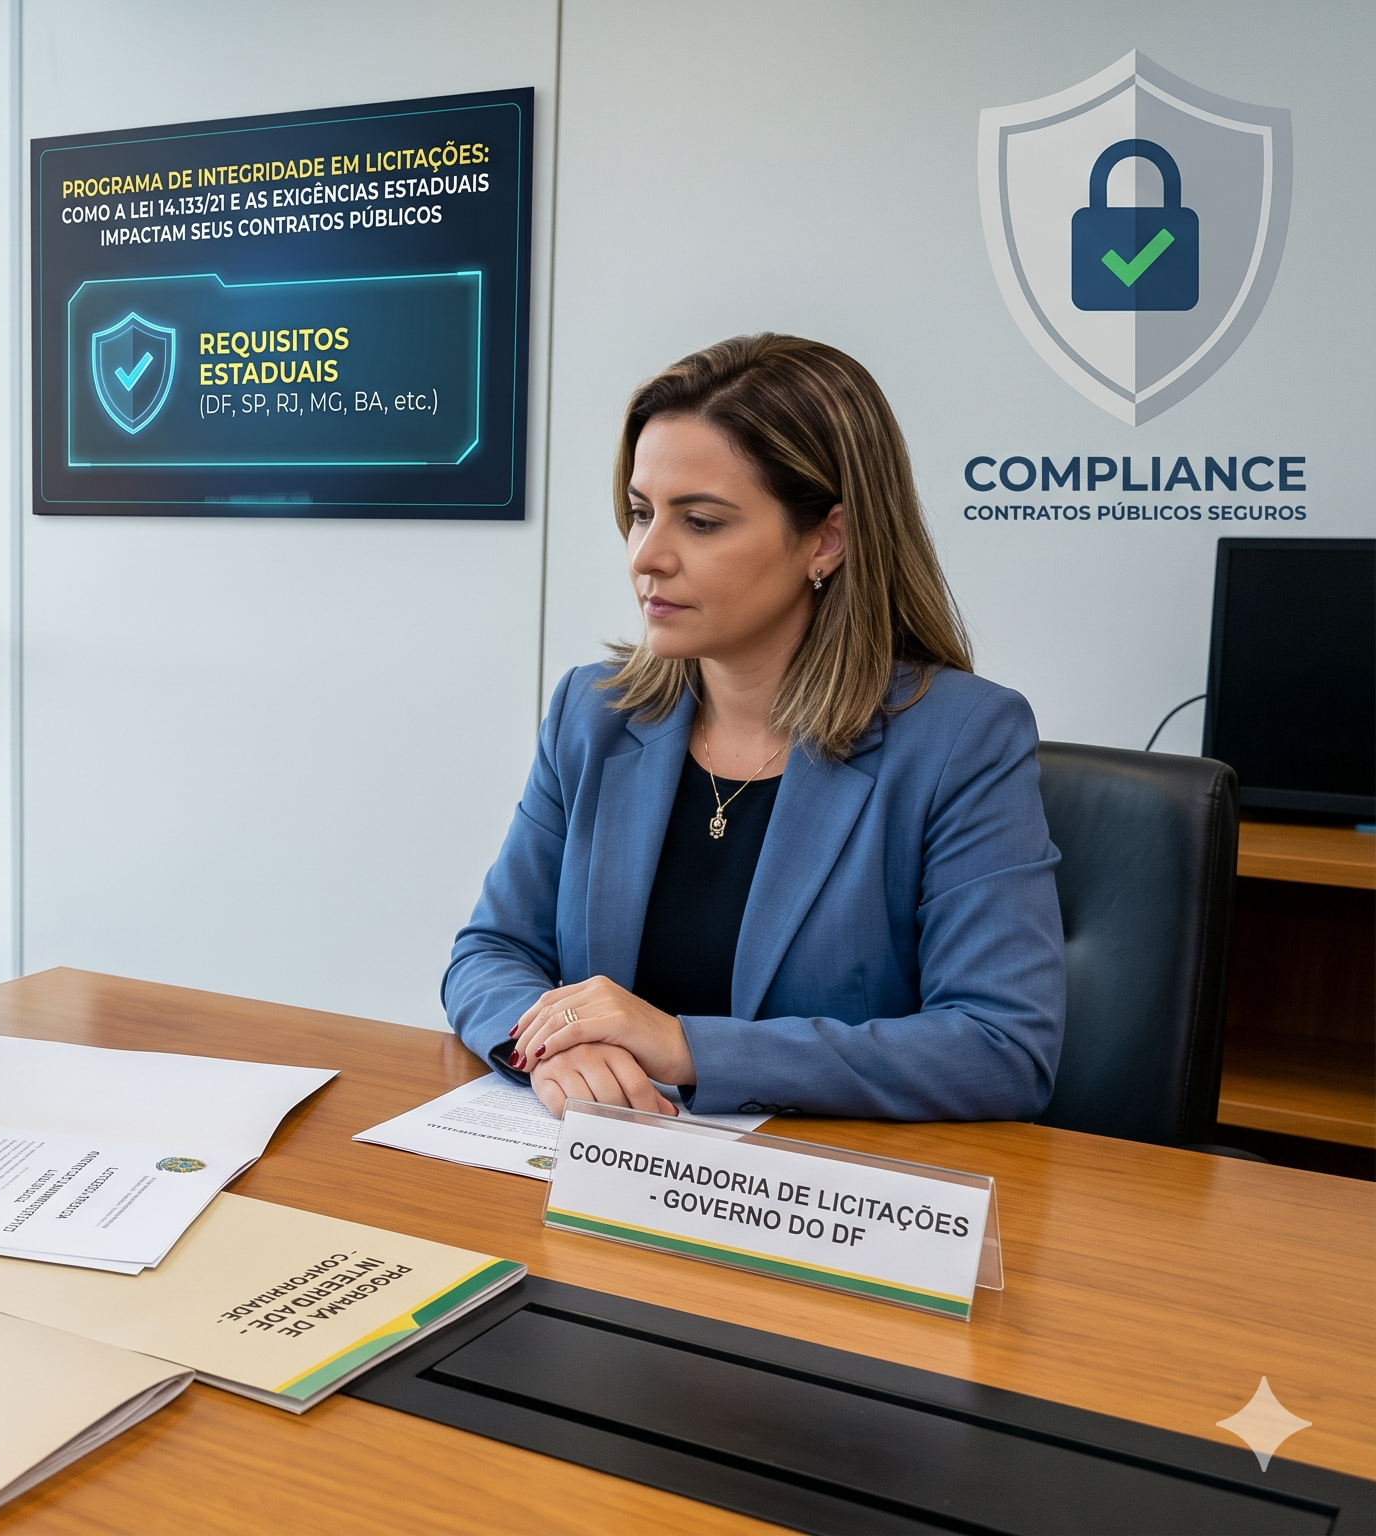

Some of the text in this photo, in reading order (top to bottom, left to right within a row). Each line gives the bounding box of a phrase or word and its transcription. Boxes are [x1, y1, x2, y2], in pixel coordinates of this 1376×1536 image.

[62, 140, 490, 198] PROGRAMA DE INTEGRIDADE EM LICITAÇÕES:
[61, 173, 490, 224] COMO A LEI 14.133/21 E AS EXIGÊNCIAS ESTADUAIS
[100, 205, 443, 247] IMPACTAM SEUS CONTRATOS PÚBLICOS
[200, 327, 349, 358] REQUISITOS
[200, 359, 339, 385] ESTADUAIS
[200, 388, 438, 419] (DF, SP, RJ, MG, BA, etc.)
[964, 455, 1307, 493] COMPLIANCE
[963, 501, 1307, 521] CONTRATOS PÚBLICOS SEGUROS
[569, 1141, 970, 1239] COORDENADORIA DE LICITAÇÕES
[663, 1189, 781, 1231] GOVERNO
[788, 1214, 824, 1239] DO
[832, 1223, 866, 1247] DF
[277, 1319, 316, 1338] DE
